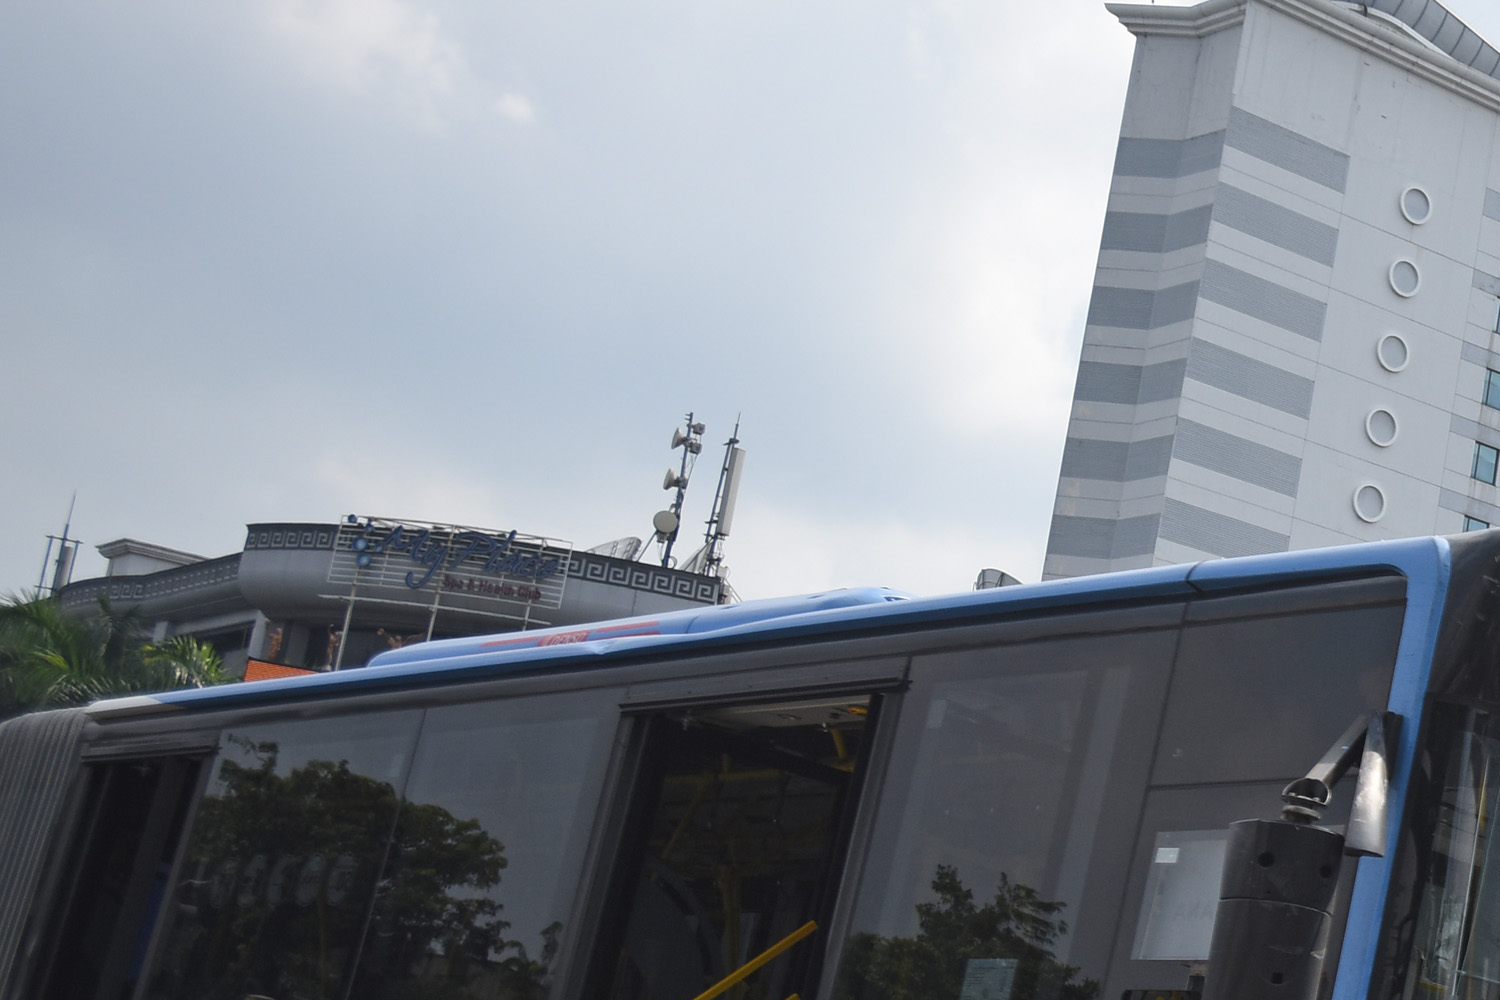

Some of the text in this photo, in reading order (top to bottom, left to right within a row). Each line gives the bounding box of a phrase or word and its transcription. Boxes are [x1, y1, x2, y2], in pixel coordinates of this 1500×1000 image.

[381, 525, 561, 590] My Place
[443, 575, 542, 600] Spa & Health Club
